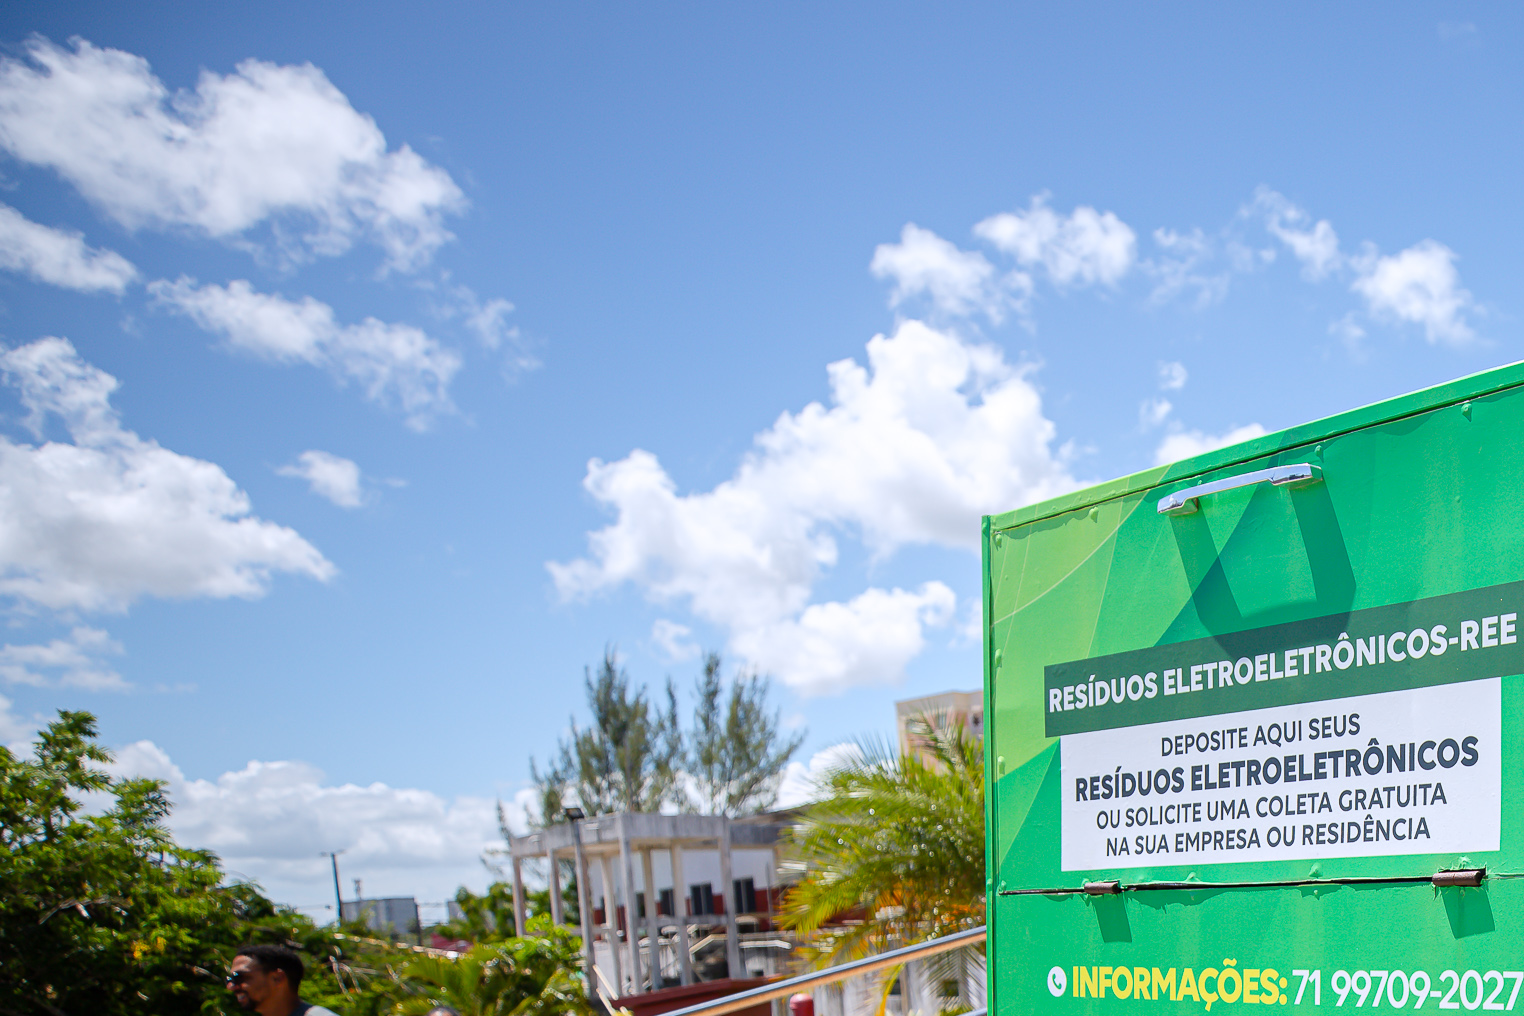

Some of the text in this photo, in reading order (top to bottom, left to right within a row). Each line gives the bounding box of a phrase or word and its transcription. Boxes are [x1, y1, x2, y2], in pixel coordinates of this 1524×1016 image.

[1049, 613, 1517, 713] RESÍDUOS ELETROELETRÔNICOS-REE
[1161, 712, 1361, 757] DEPOSITE AQUI SEUS
[1075, 735, 1479, 802] RESÍDUOS ELETROELETRÔNICOS
[1096, 782, 1447, 830] OU SOLICITE UMA COLETA GRATUITA
[1106, 814, 1431, 857] NA SUA EMPRESA OU RESIDÊNCIA
[1072, 958, 1524, 1012] INFORMAÇÕES: 71 99709-2027
